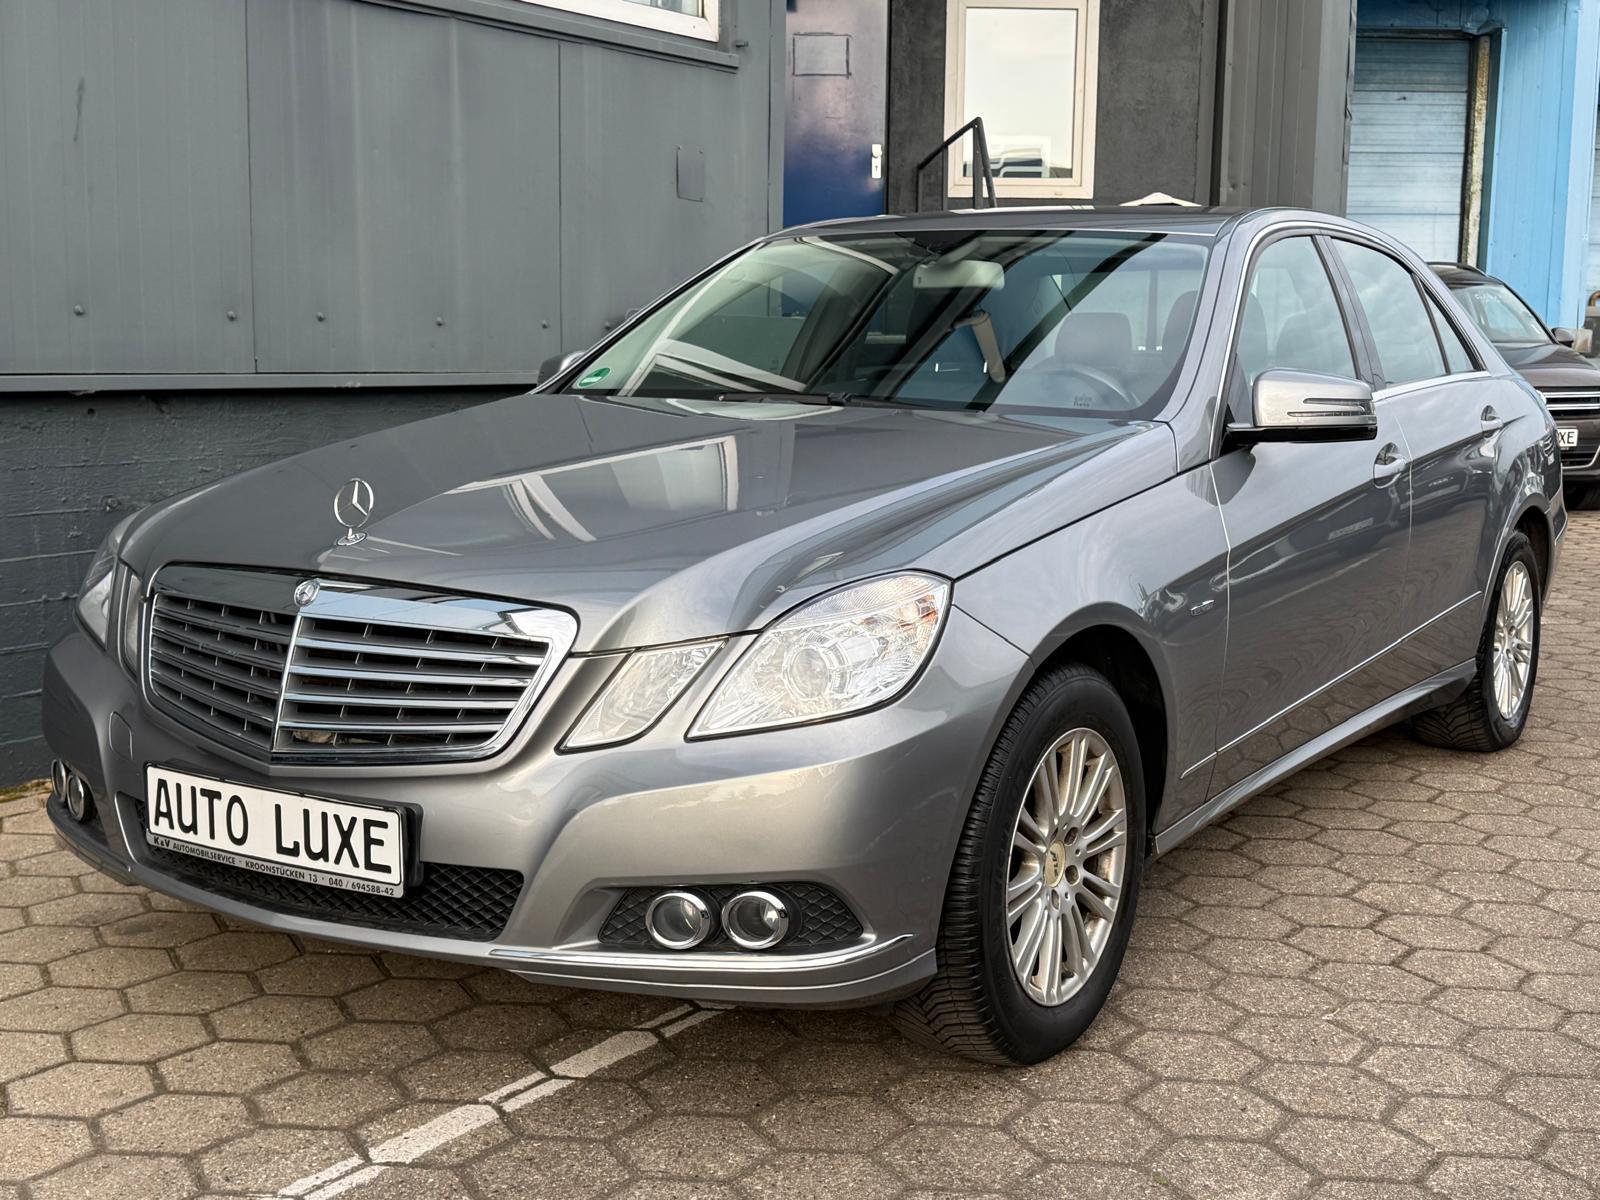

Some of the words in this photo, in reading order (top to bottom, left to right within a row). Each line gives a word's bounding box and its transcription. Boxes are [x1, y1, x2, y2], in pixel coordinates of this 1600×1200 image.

[1557, 431, 1575, 445] XE
[154, 778, 249, 846] AUTO
[274, 803, 392, 874] LUXE
[153, 836, 171, 848] K&V
[173, 842, 236, 865] AUTOMOBILSERVICE
[245, 860, 305, 879] KROONSTÜCKEN
[308, 873, 318, 883] 13
[328, 877, 343, 888] 040
[351, 881, 394, 896] 694588-42
